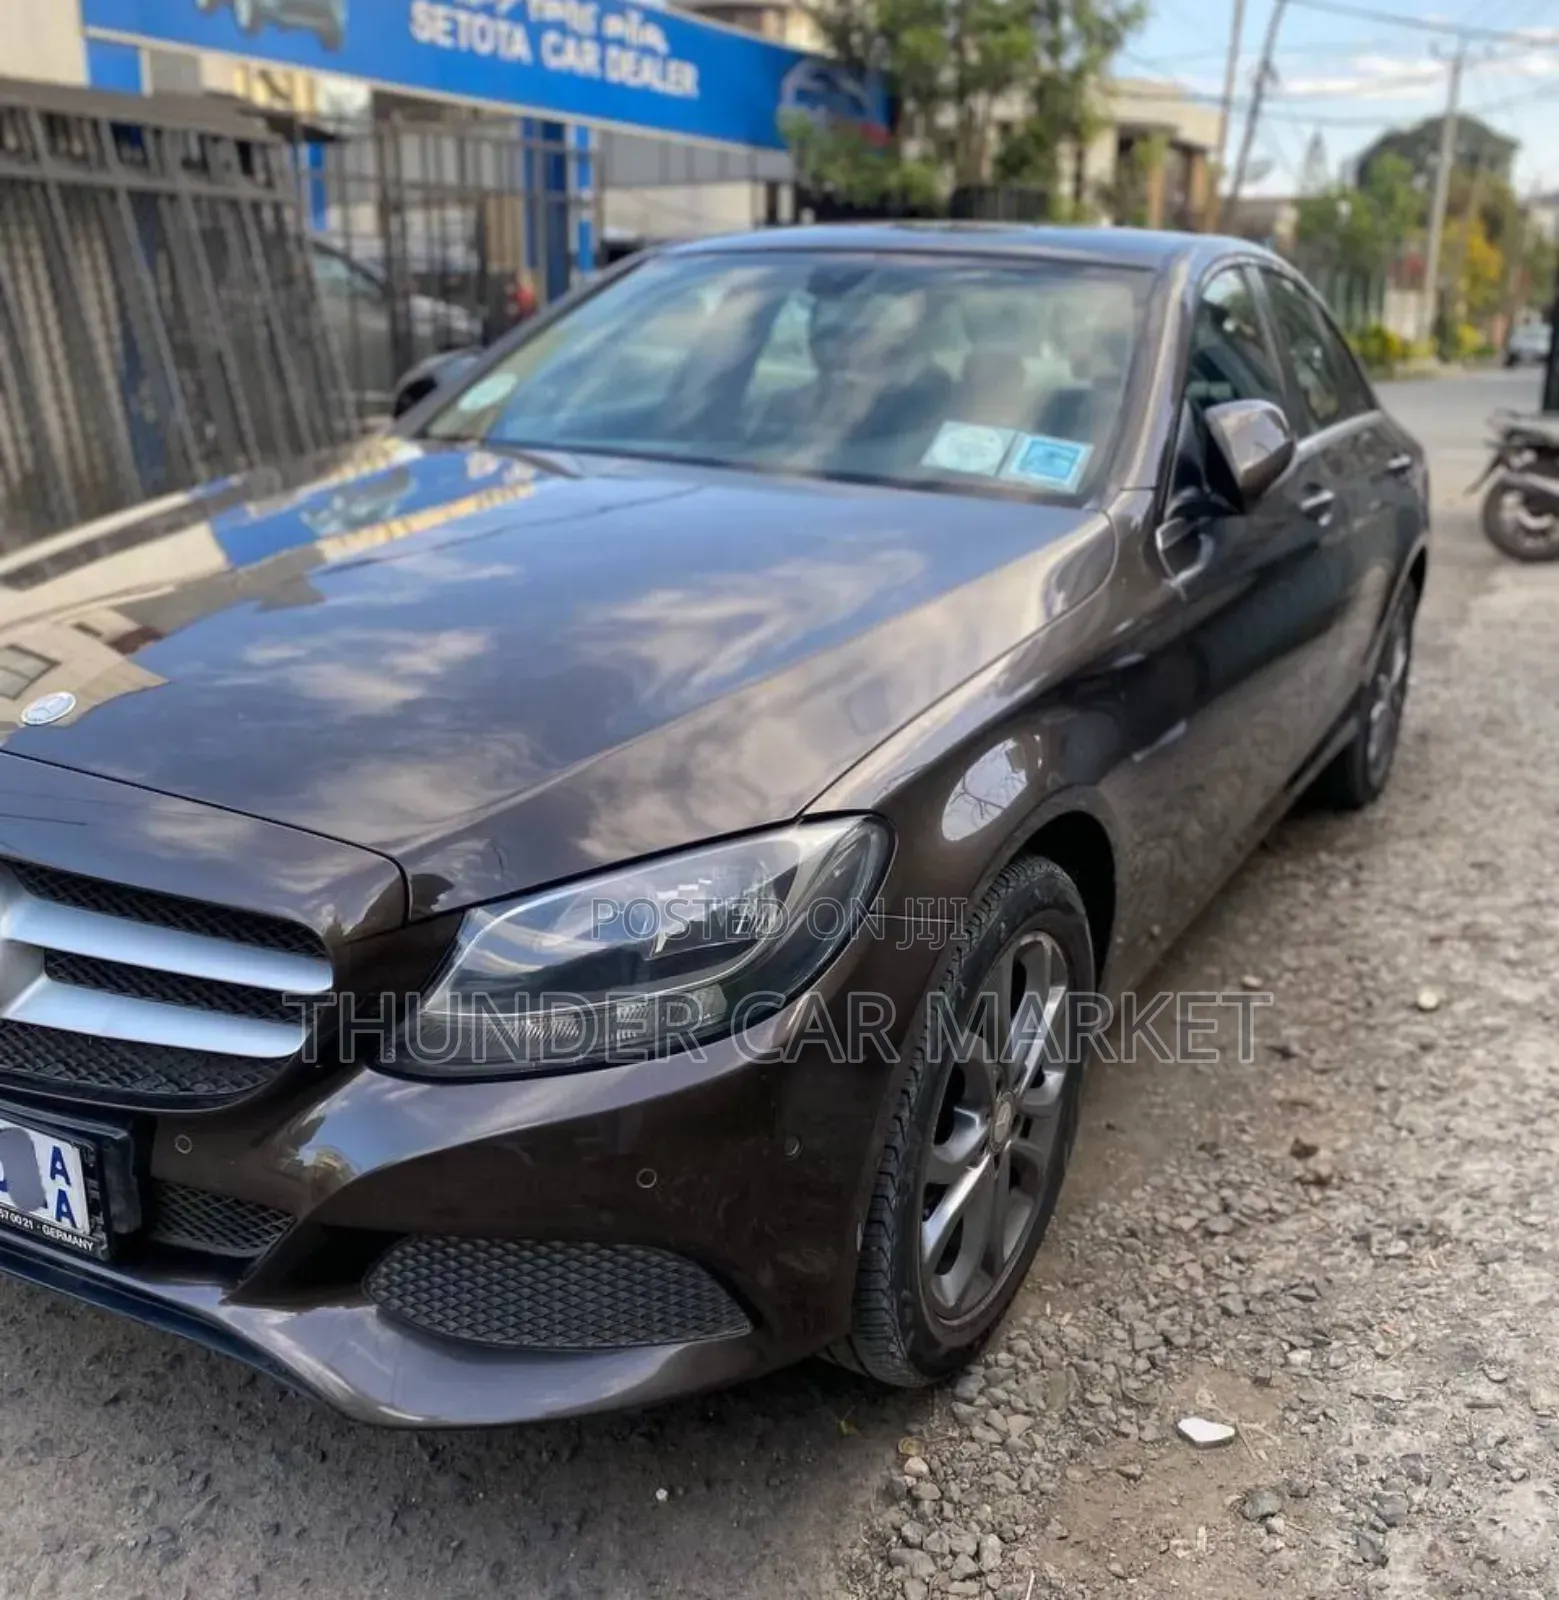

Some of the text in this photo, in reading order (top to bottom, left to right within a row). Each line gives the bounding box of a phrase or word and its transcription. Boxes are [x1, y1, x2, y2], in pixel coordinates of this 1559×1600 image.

[408, 0, 535, 66] SETOTA
[540, 29, 602, 80] CAR
[604, 44, 701, 99] DEALER
[41, 1224, 94, 1251] GERMANY
